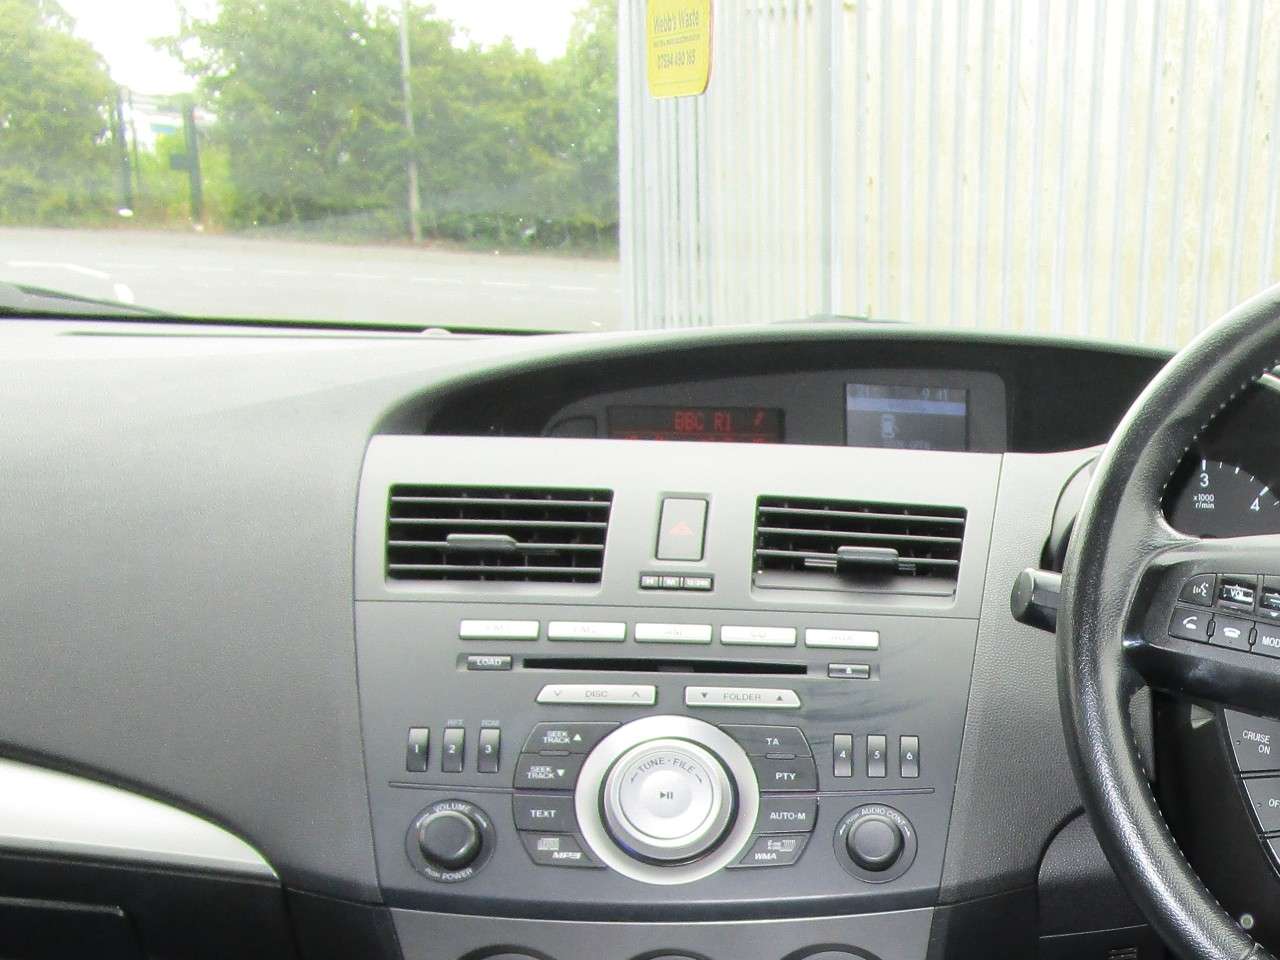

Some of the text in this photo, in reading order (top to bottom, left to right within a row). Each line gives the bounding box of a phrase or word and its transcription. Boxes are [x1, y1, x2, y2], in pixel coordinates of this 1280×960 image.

[674, 410, 704, 432] BBC
[1200, 473, 1209, 487] 3
[1250, 497, 1260, 511] 4
[1230, 588, 1245, 598] VOL
[475, 658, 503, 666] LOAD
[584, 689, 608, 698] DISC
[723, 692, 761, 701] FOLDER
[543, 736, 571, 744] TRACK
[766, 737, 780, 746] TA
[1242, 729, 1271, 745] CRUISE
[449, 744, 456, 754] 2
[484, 744, 492, 754] 3
[1258, 744, 1271, 755] ON
[839, 750, 847, 759] 4
[873, 750, 881, 759] 5
[906, 752, 913, 760] 6
[638, 757, 696, 774] TUNE FILE
[775, 772, 796, 781] PTY
[433, 802, 472, 813] VOLUME
[861, 807, 886, 816] AUDIO
[530, 809, 557, 818] TEXT
[770, 812, 806, 820] AUTO-M
[442, 867, 473, 880] POWER
